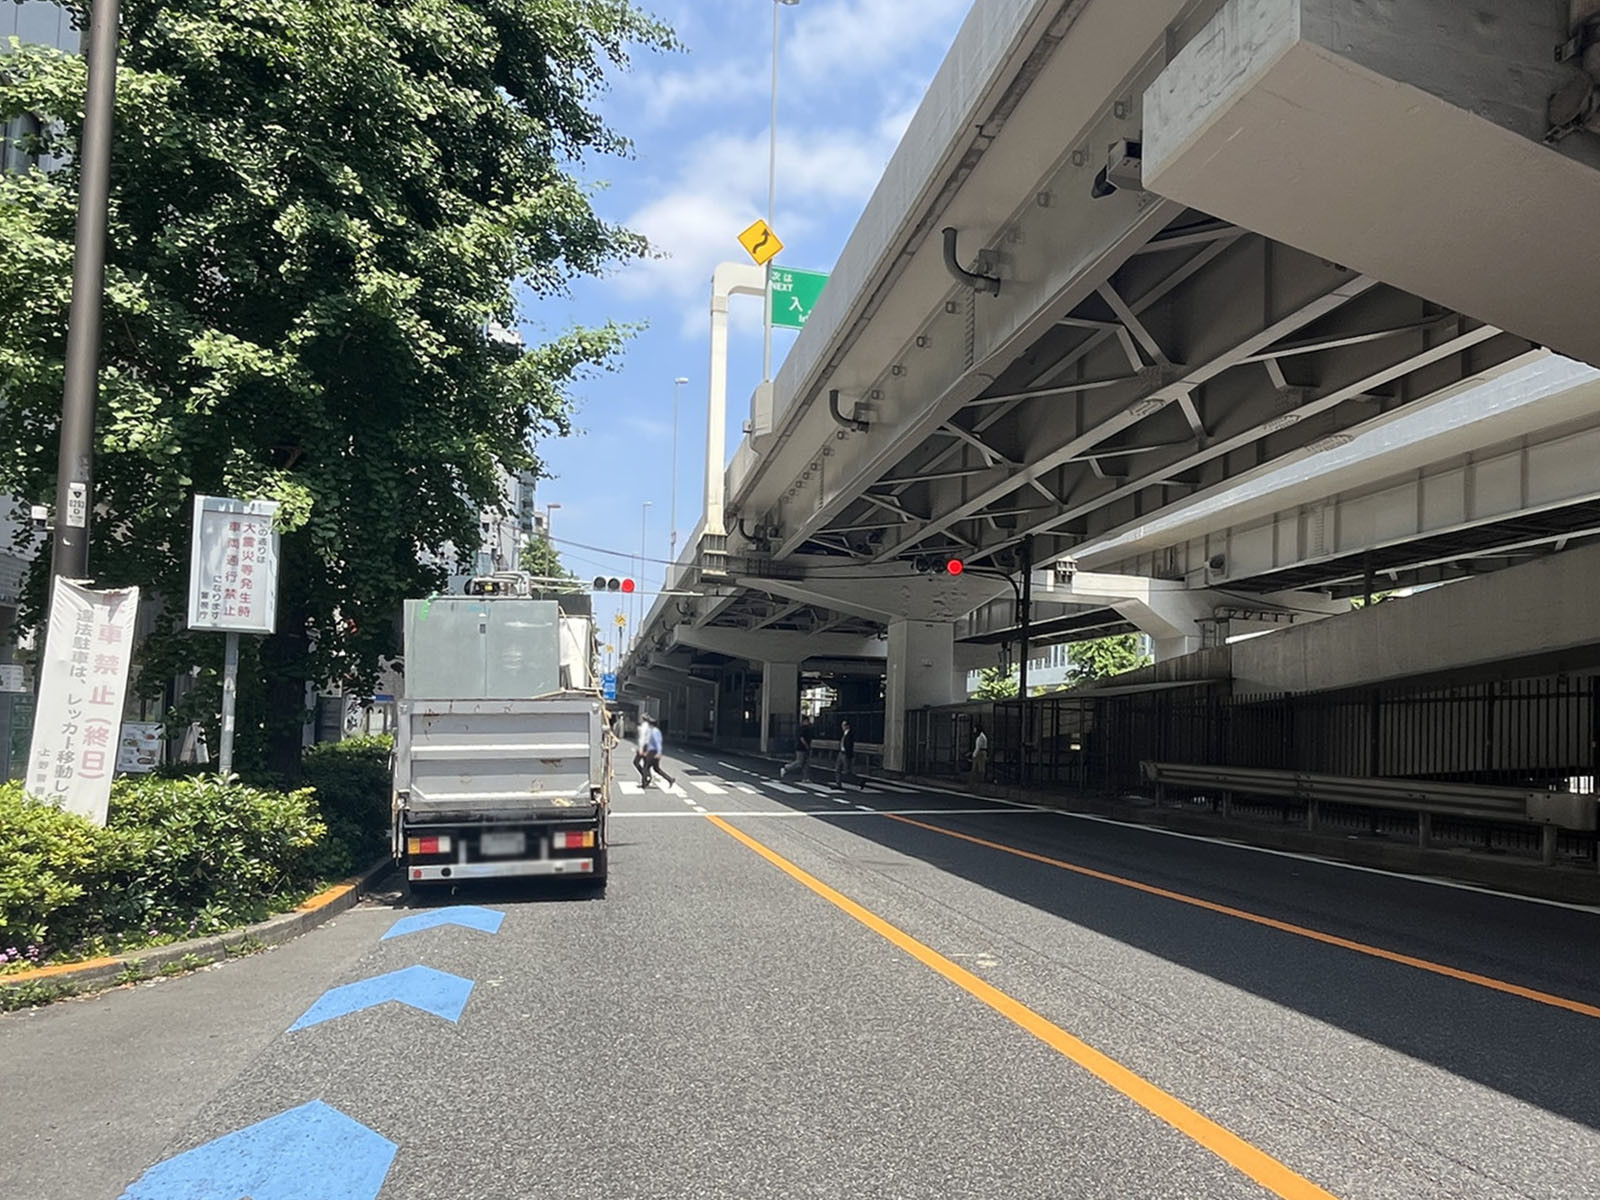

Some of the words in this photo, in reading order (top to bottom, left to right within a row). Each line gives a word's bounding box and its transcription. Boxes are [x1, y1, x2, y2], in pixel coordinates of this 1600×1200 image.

[772, 271, 792, 282] 次は
[772, 282, 793, 292] NEXT
[789, 296, 804, 312] 入
[223, 521, 240, 616] 車両通行禁止
[238, 523, 256, 617] 大震災等発生時
[211, 575, 222, 620] になります
